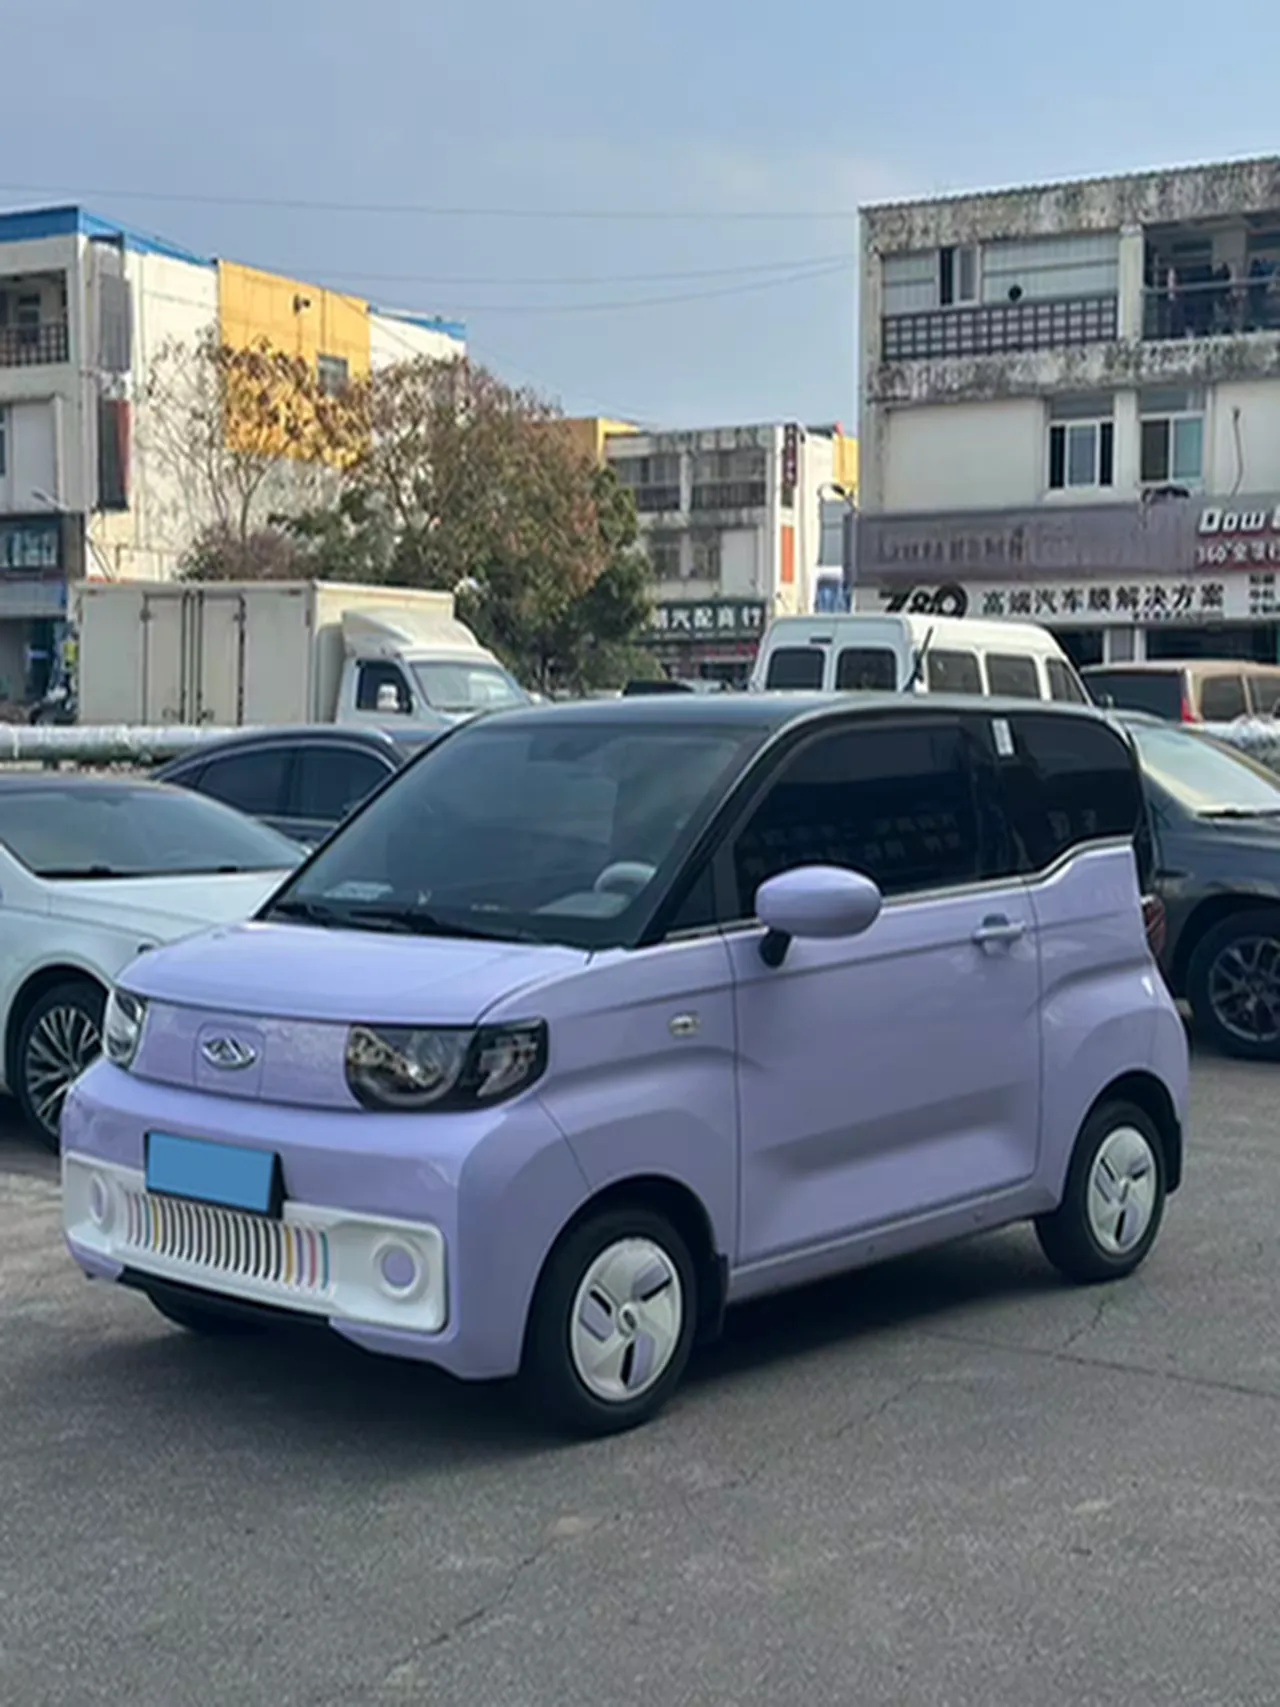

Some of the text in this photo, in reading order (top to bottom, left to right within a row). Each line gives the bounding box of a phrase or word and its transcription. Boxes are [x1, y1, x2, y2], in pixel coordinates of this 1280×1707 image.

[982, 582, 1224, 616] 高端汽车膜解决方案
